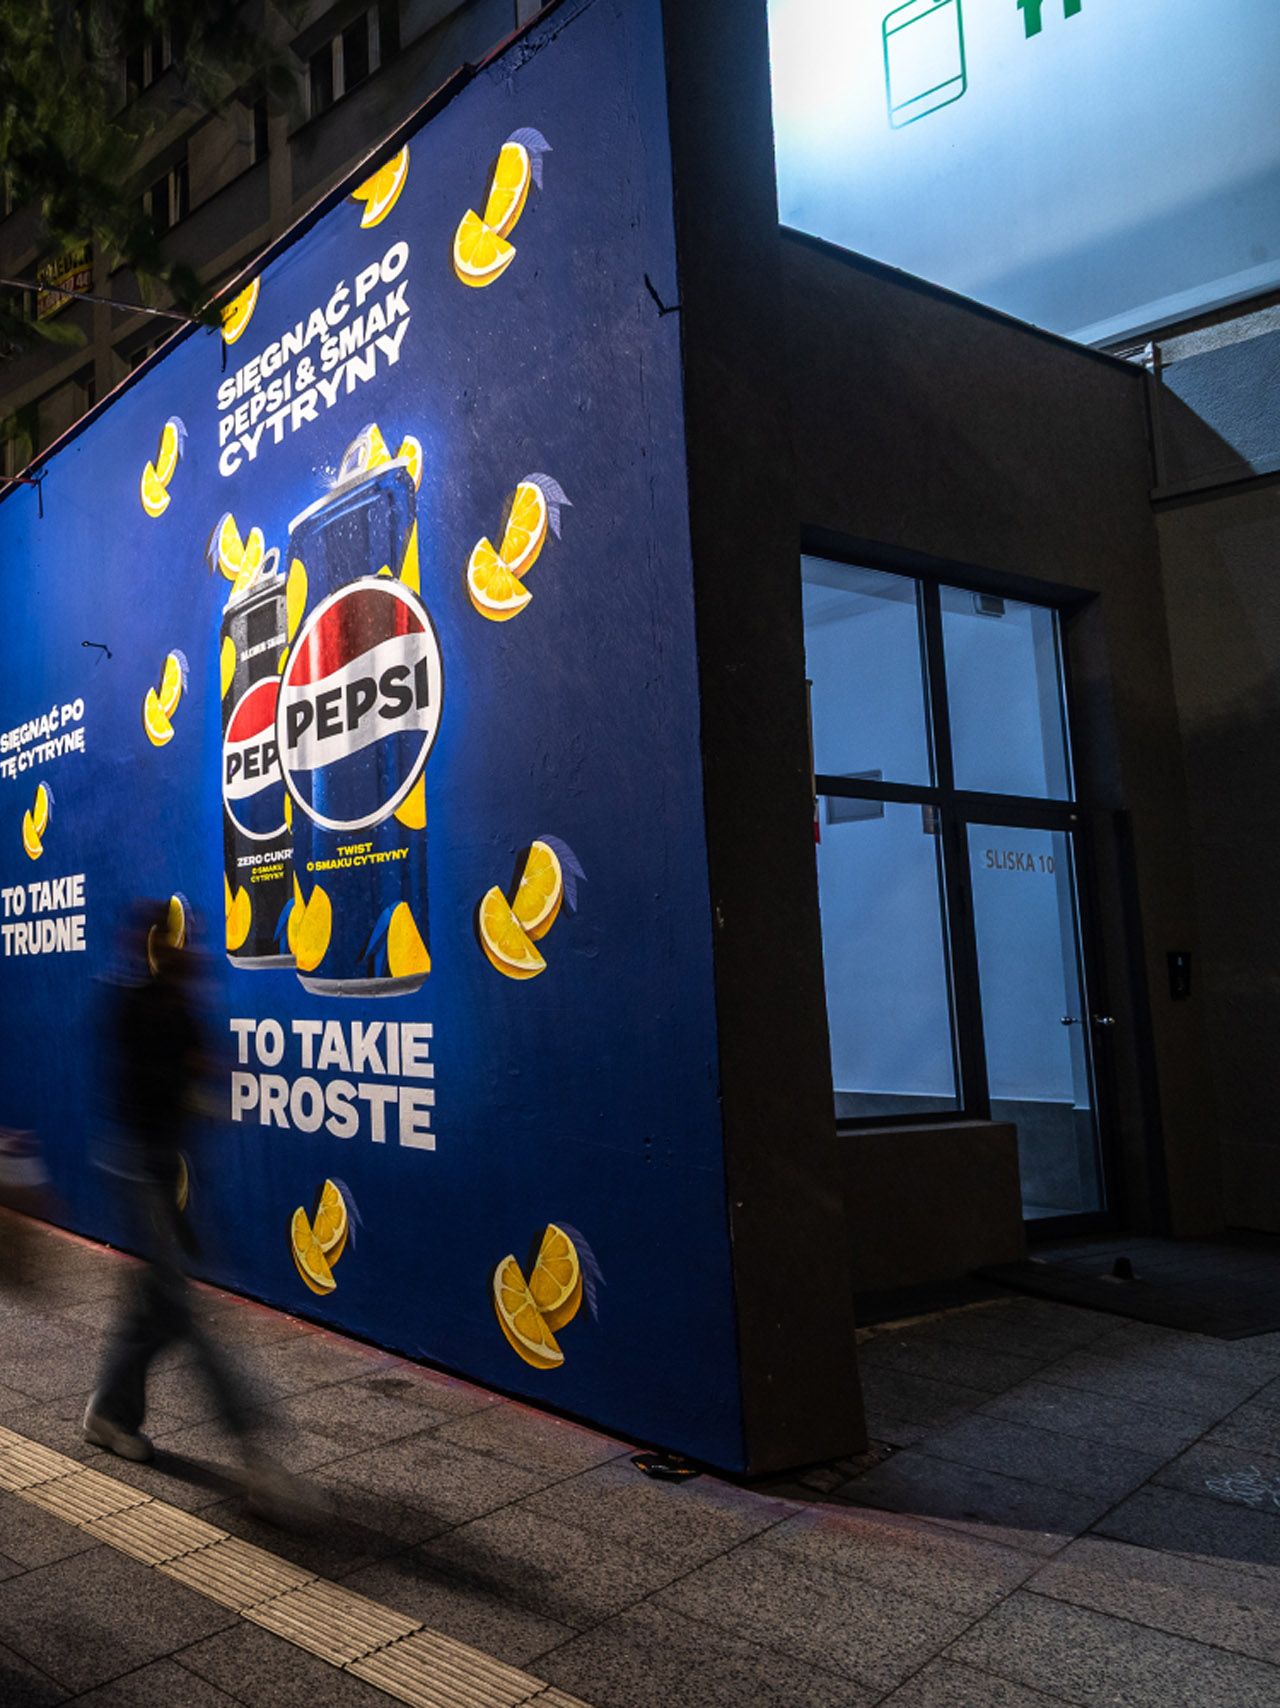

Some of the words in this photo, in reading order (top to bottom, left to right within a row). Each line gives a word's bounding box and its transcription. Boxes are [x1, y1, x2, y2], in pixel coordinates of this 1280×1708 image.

[217, 280, 352, 410] SIĘGNĄĆ
[355, 241, 410, 307] PO
[219, 370, 291, 446] PEPSI
[294, 356, 316, 391] &
[321, 280, 411, 373] SMAK
[219, 316, 411, 477] CYTRYNY
[0, 705, 59, 754] SIĘGNĄĆ
[61, 698, 85, 726] PO
[287, 655, 429, 749] PEPSI
[0, 759, 17, 780] TĘ
[18, 727, 85, 773] CYTRYNĘ
[226, 740, 279, 785] PEP
[237, 854, 263, 867] ZERO
[306, 861, 315, 872] O
[315, 857, 352, 871] SMAKU
[353, 848, 409, 867] CYTRYNY
[337, 842, 373, 857] TWIST
[1039, 855, 1056, 874] 10
[1, 884, 26, 917] TO
[28, 873, 86, 914] TAKIE
[1, 914, 86, 956] TRUDNE
[230, 1018, 285, 1067] TO
[291, 1020, 435, 1079] TAKIE
[231, 1071, 436, 1151] PROSTE
